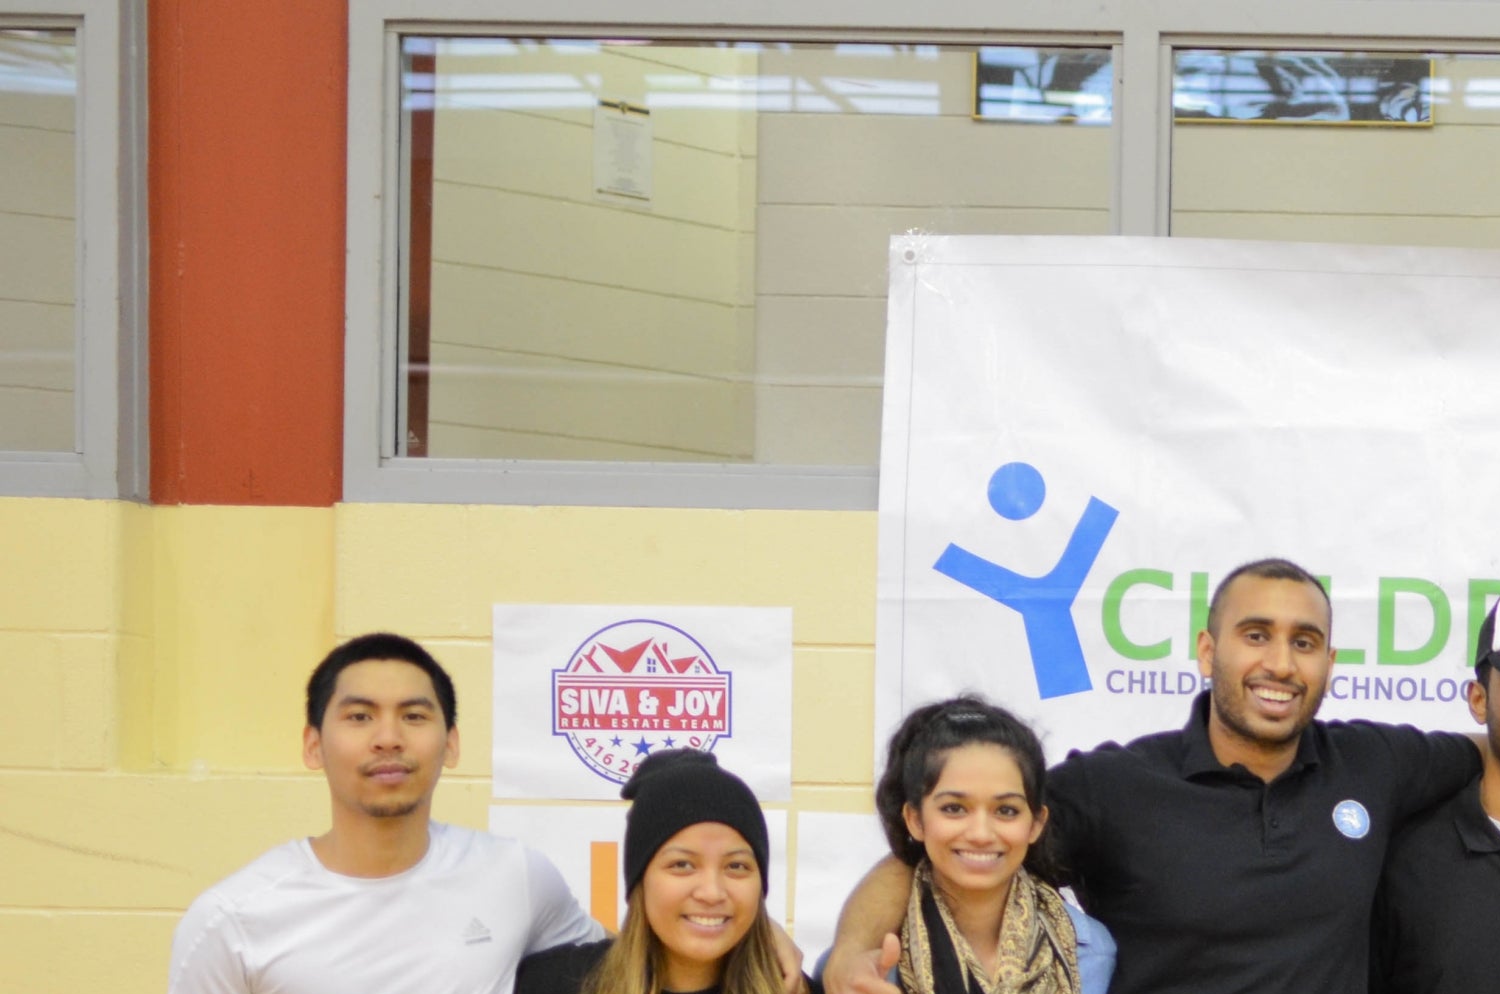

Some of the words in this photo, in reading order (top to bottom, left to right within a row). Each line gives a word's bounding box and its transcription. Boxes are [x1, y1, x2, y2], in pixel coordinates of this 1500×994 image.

[1106, 669, 1212, 695] CHILD
[1323, 675, 1470, 702] CHNOLO
[560, 688, 630, 716] SIVA
[638, 689, 659, 716] &
[667, 689, 723, 717] JOY
[561, 718, 601, 728] REAL
[611, 718, 671, 728] ESTATE
[680, 719, 723, 729] TEAM
